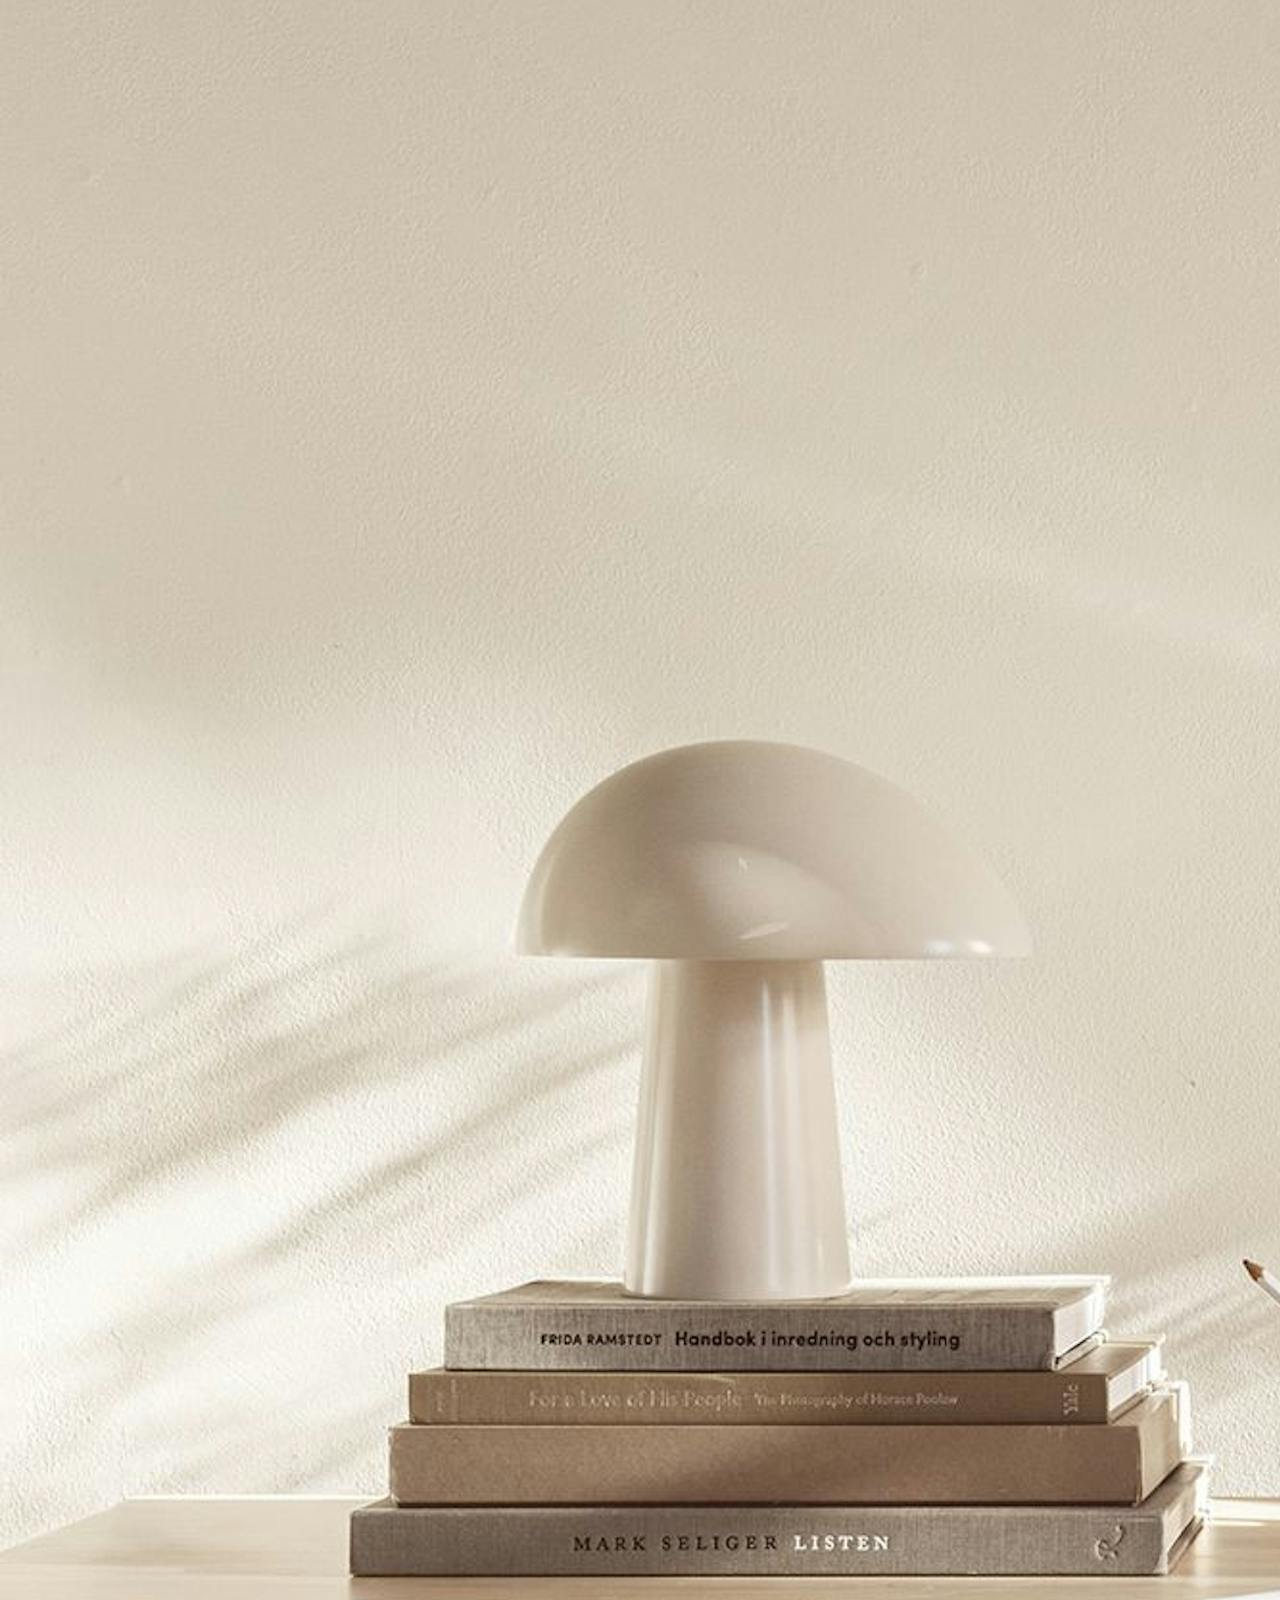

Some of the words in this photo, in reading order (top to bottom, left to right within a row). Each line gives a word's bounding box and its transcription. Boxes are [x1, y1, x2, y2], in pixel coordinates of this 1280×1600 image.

[541, 1333, 582, 1346] FRIDA
[586, 1333, 662, 1346] RAMSTEDT
[675, 1331, 756, 1347] Handbok
[761, 1331, 767, 1347] i
[771, 1331, 858, 1350] inredning
[863, 1331, 895, 1347] och
[900, 1331, 961, 1350] styling
[683, 1388, 742, 1411] People
[573, 1535, 647, 1551] MARK
[661, 1535, 778, 1551] SELIGER
[793, 1534, 890, 1551] LISTEN
